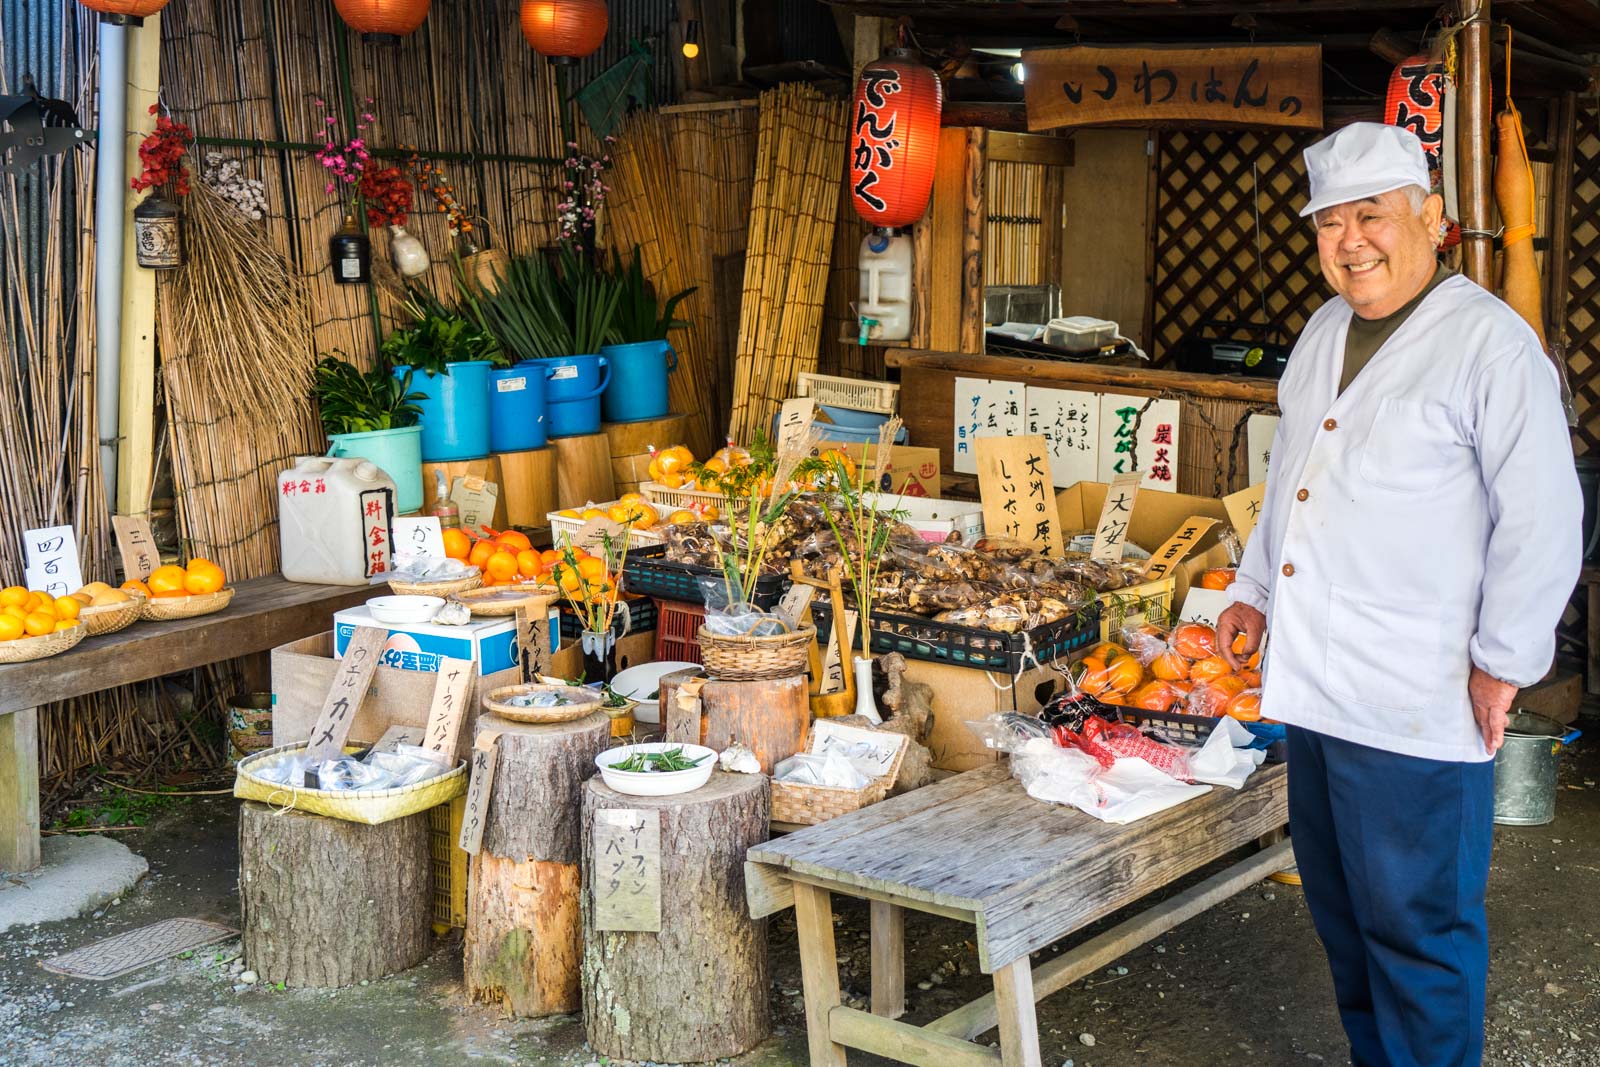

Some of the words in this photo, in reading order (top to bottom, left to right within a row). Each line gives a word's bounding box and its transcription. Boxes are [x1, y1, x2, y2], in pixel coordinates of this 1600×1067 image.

[854, 68, 902, 212] でんがく
[1396, 63, 1446, 171] でん
[282, 478, 327, 498] 料金箱
[1150, 423, 1173, 482] 炭火焼
[1000, 459, 1021, 538] しいたけ
[37, 535, 69, 597] 四百円
[365, 499, 387, 576] 料金箱
[629, 819, 648, 895] サーフィン
